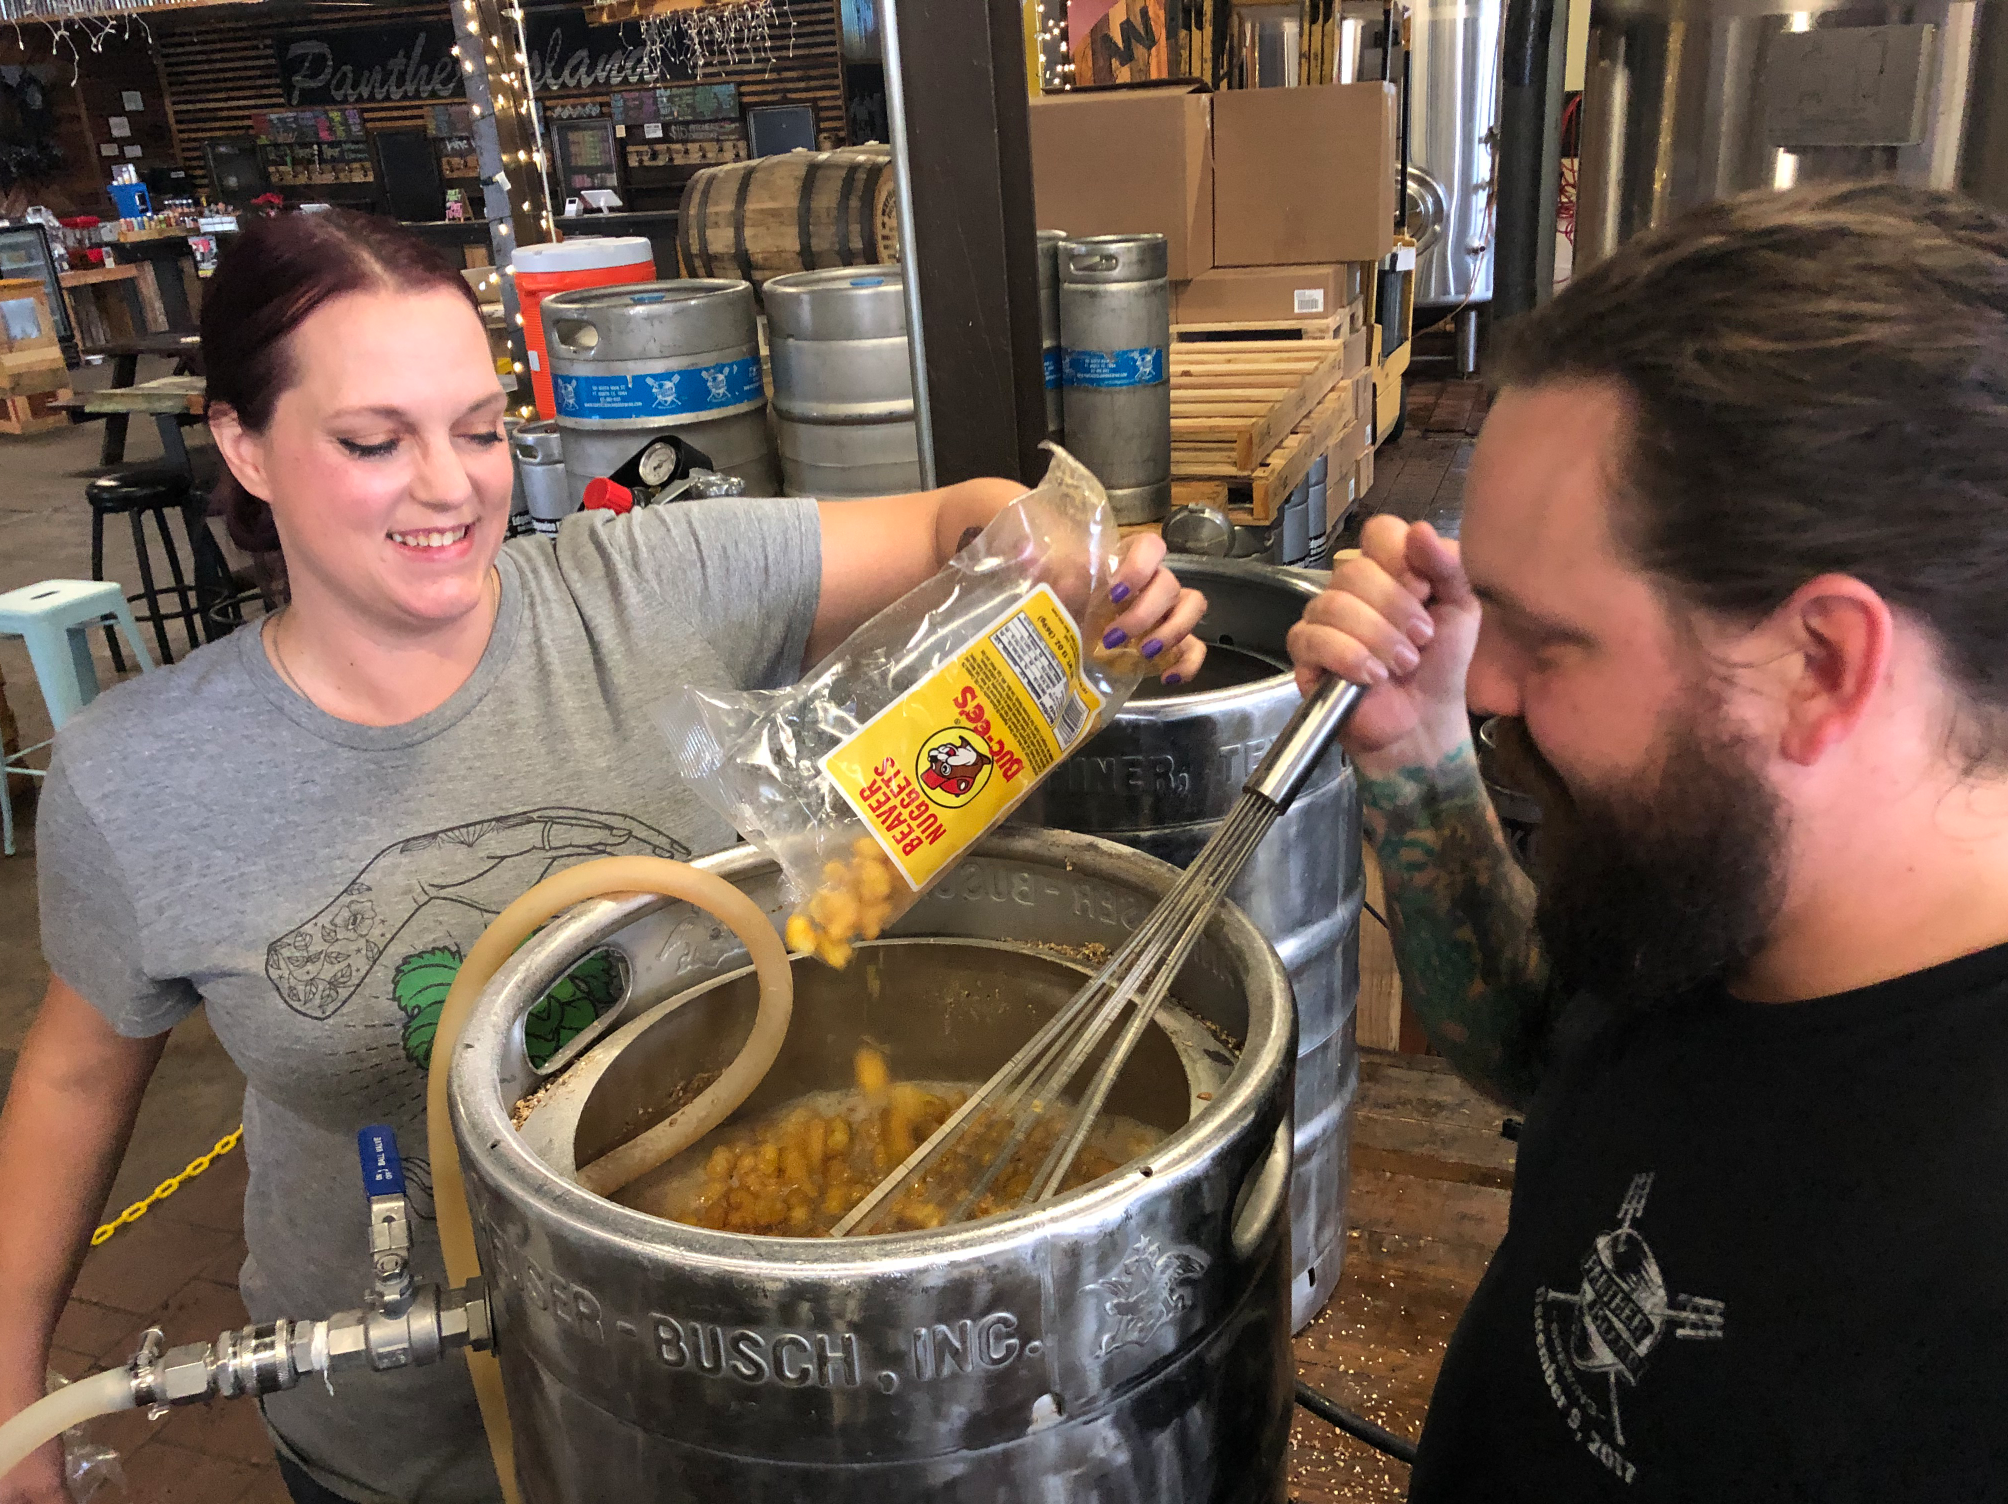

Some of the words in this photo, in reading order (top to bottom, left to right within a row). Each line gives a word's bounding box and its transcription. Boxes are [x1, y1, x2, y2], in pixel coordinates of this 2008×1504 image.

[286, 31, 463, 106] Panthe
[859, 778, 924, 857] BEAVER
[873, 756, 947, 846] NUGGETS
